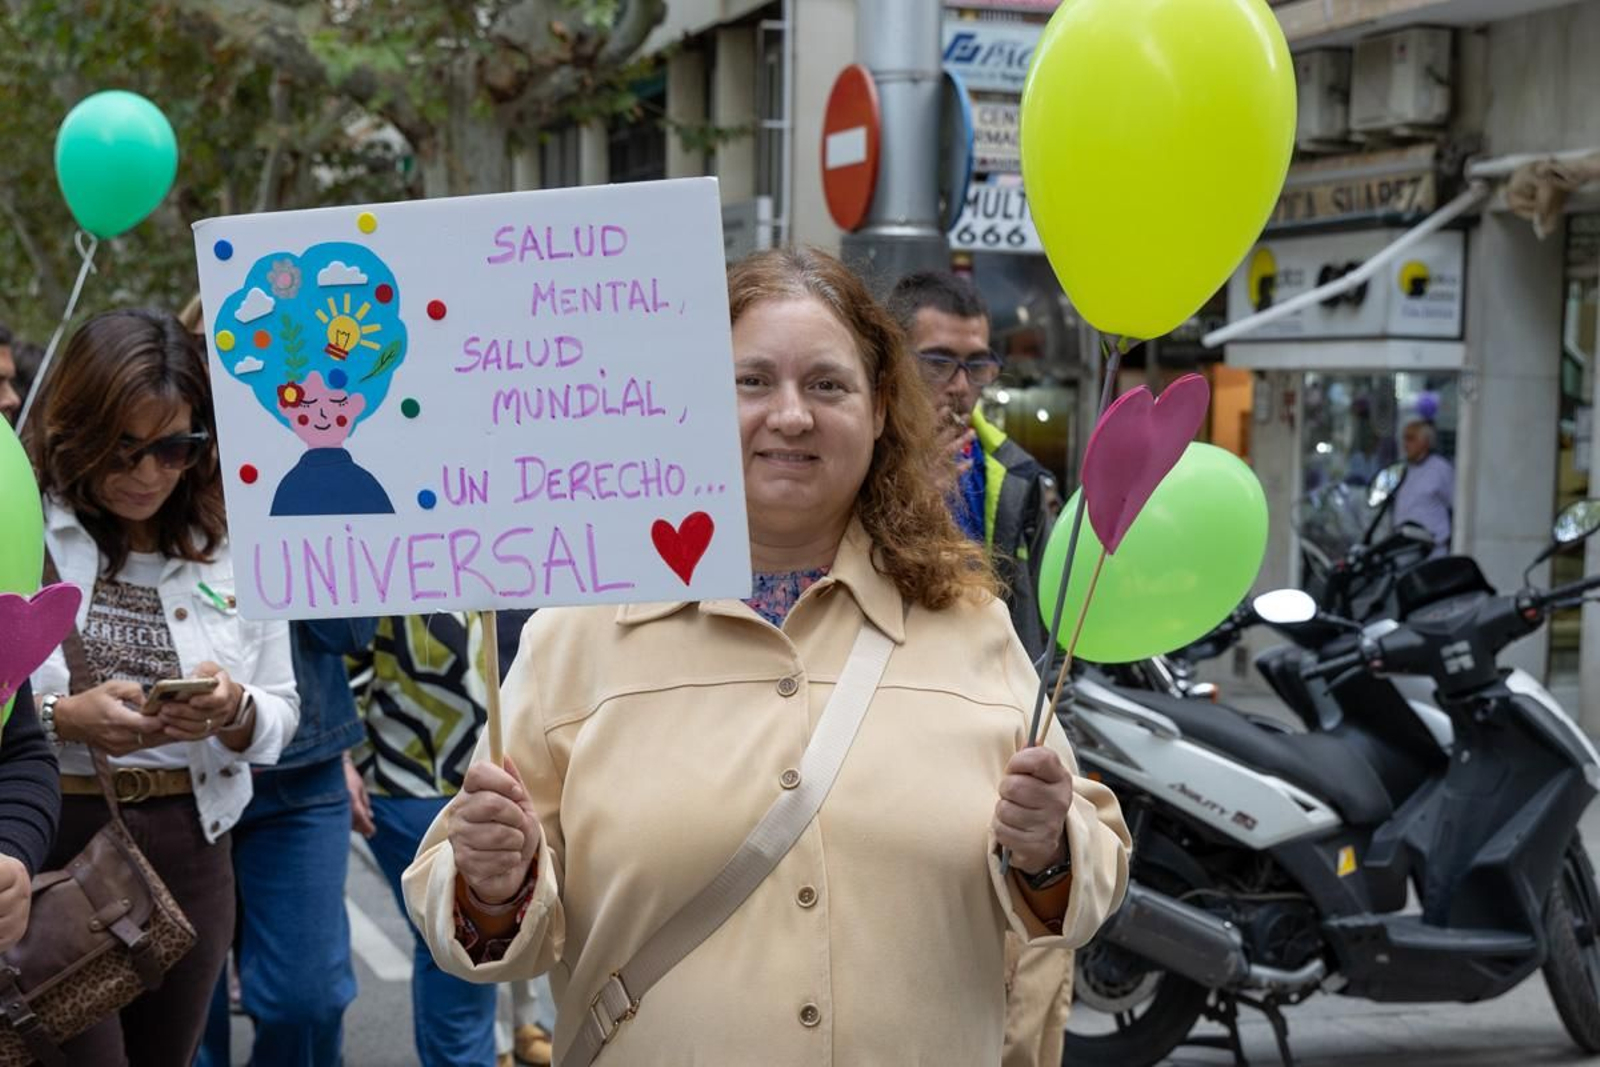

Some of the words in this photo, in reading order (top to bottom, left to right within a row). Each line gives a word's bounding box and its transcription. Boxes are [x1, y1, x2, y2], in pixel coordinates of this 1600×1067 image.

[487, 223, 628, 265] SALUD
[957, 224, 1027, 247] 666
[454, 335, 584, 374] SALUD
[441, 464, 490, 508] UN
